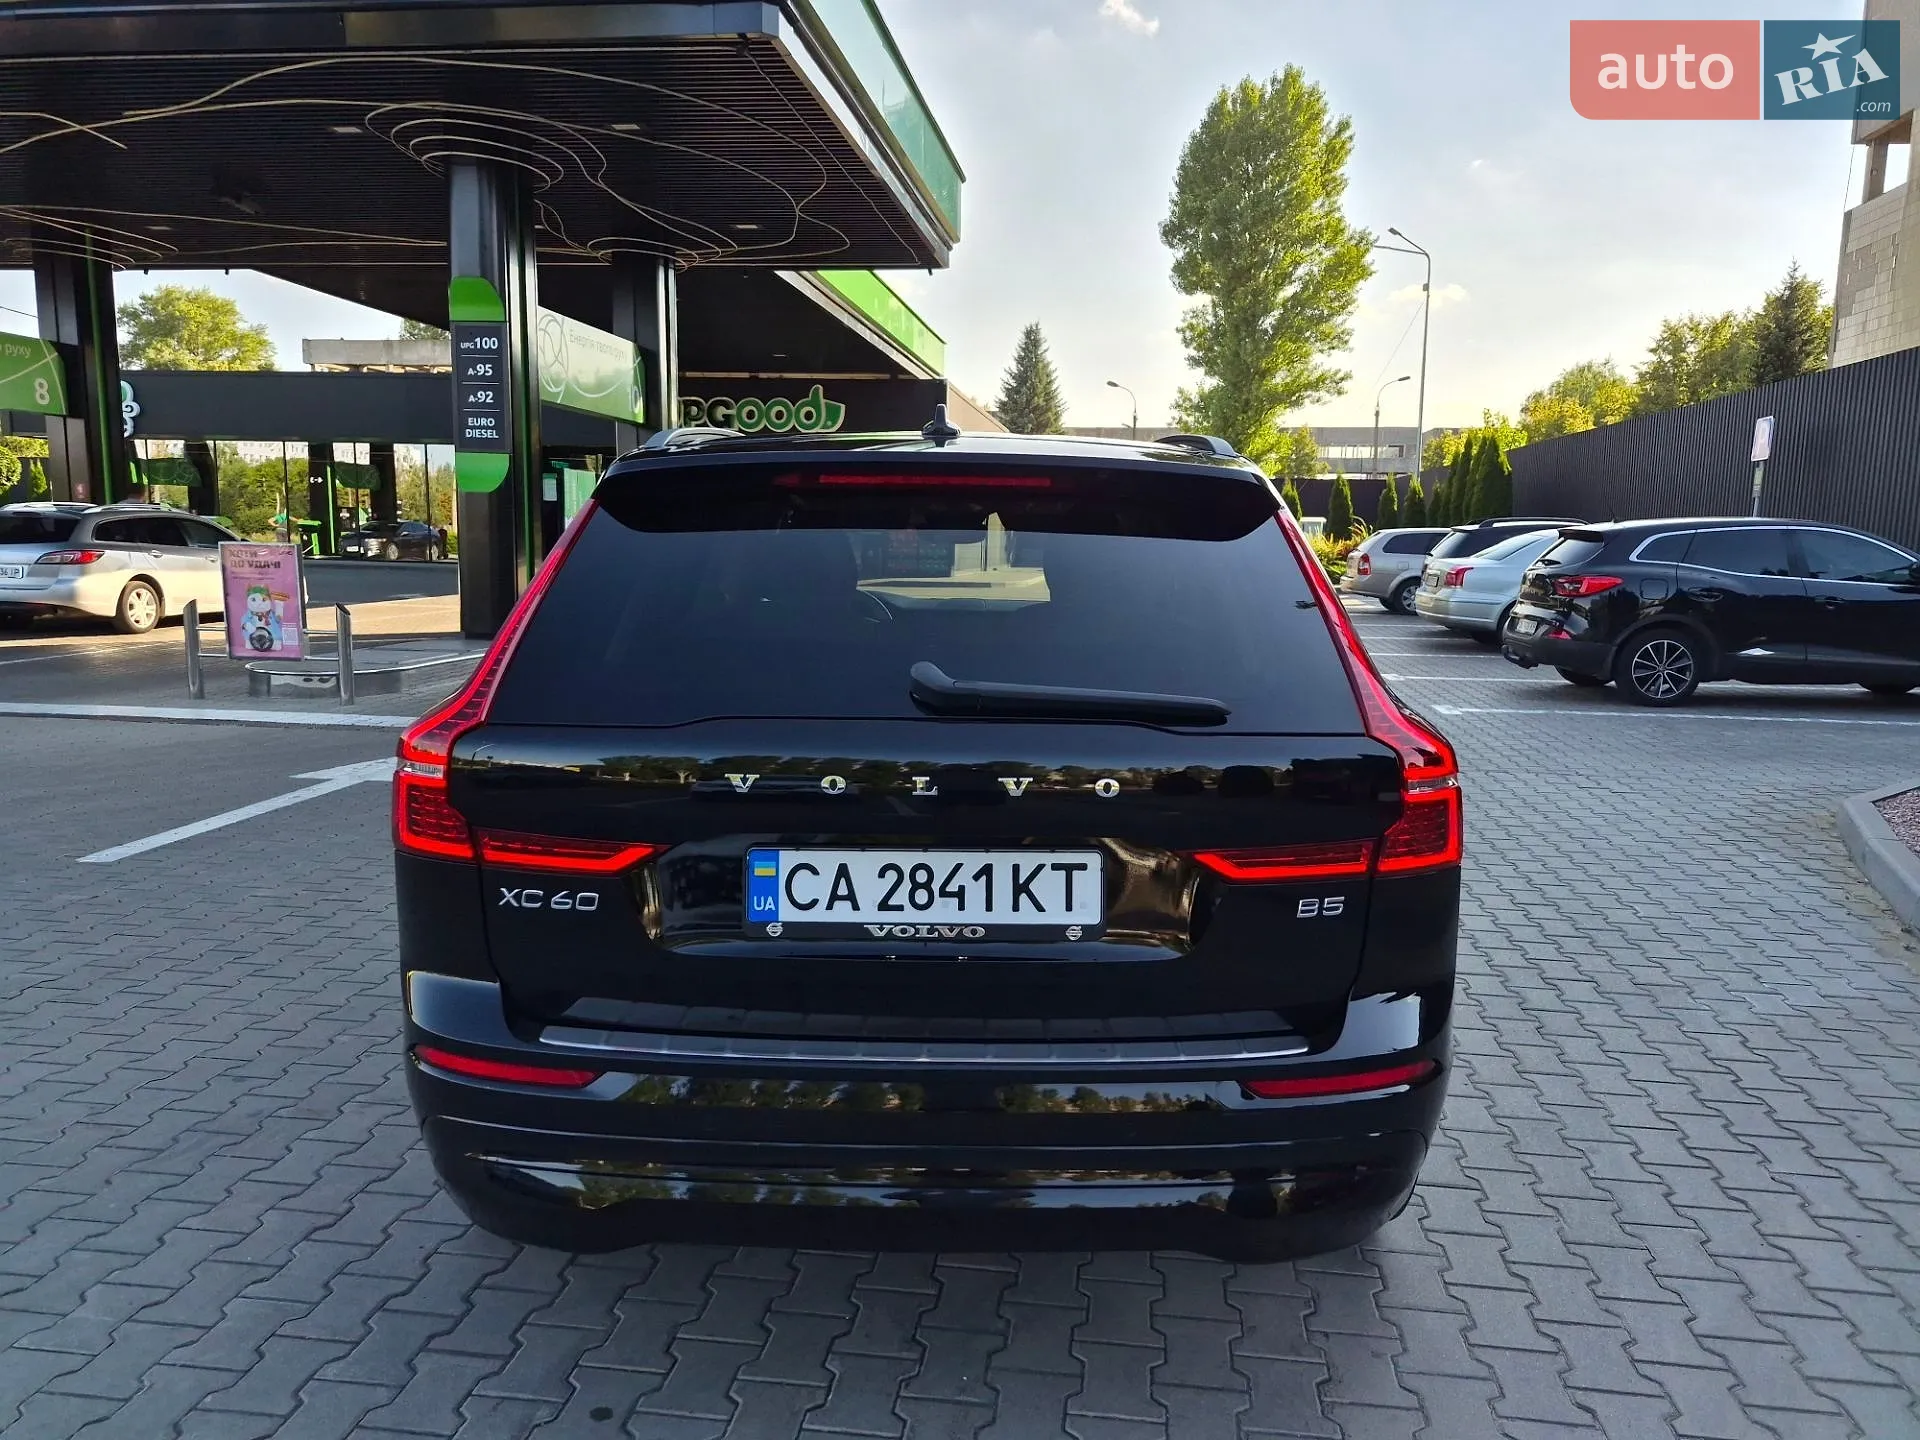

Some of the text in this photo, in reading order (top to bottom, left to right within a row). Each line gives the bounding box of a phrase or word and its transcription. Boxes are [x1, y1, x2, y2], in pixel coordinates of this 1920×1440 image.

[34, 378, 50, 405] 8
[468, 417, 495, 427] EURO
[465, 429, 499, 439] DIESEL
[724, 773, 1121, 798] VOLVO
[784, 862, 1088, 912] CA 2841 KT
[753, 895, 776, 912] UA
[1296, 896, 1345, 918] B5
[863, 924, 986, 939] VOLVO
